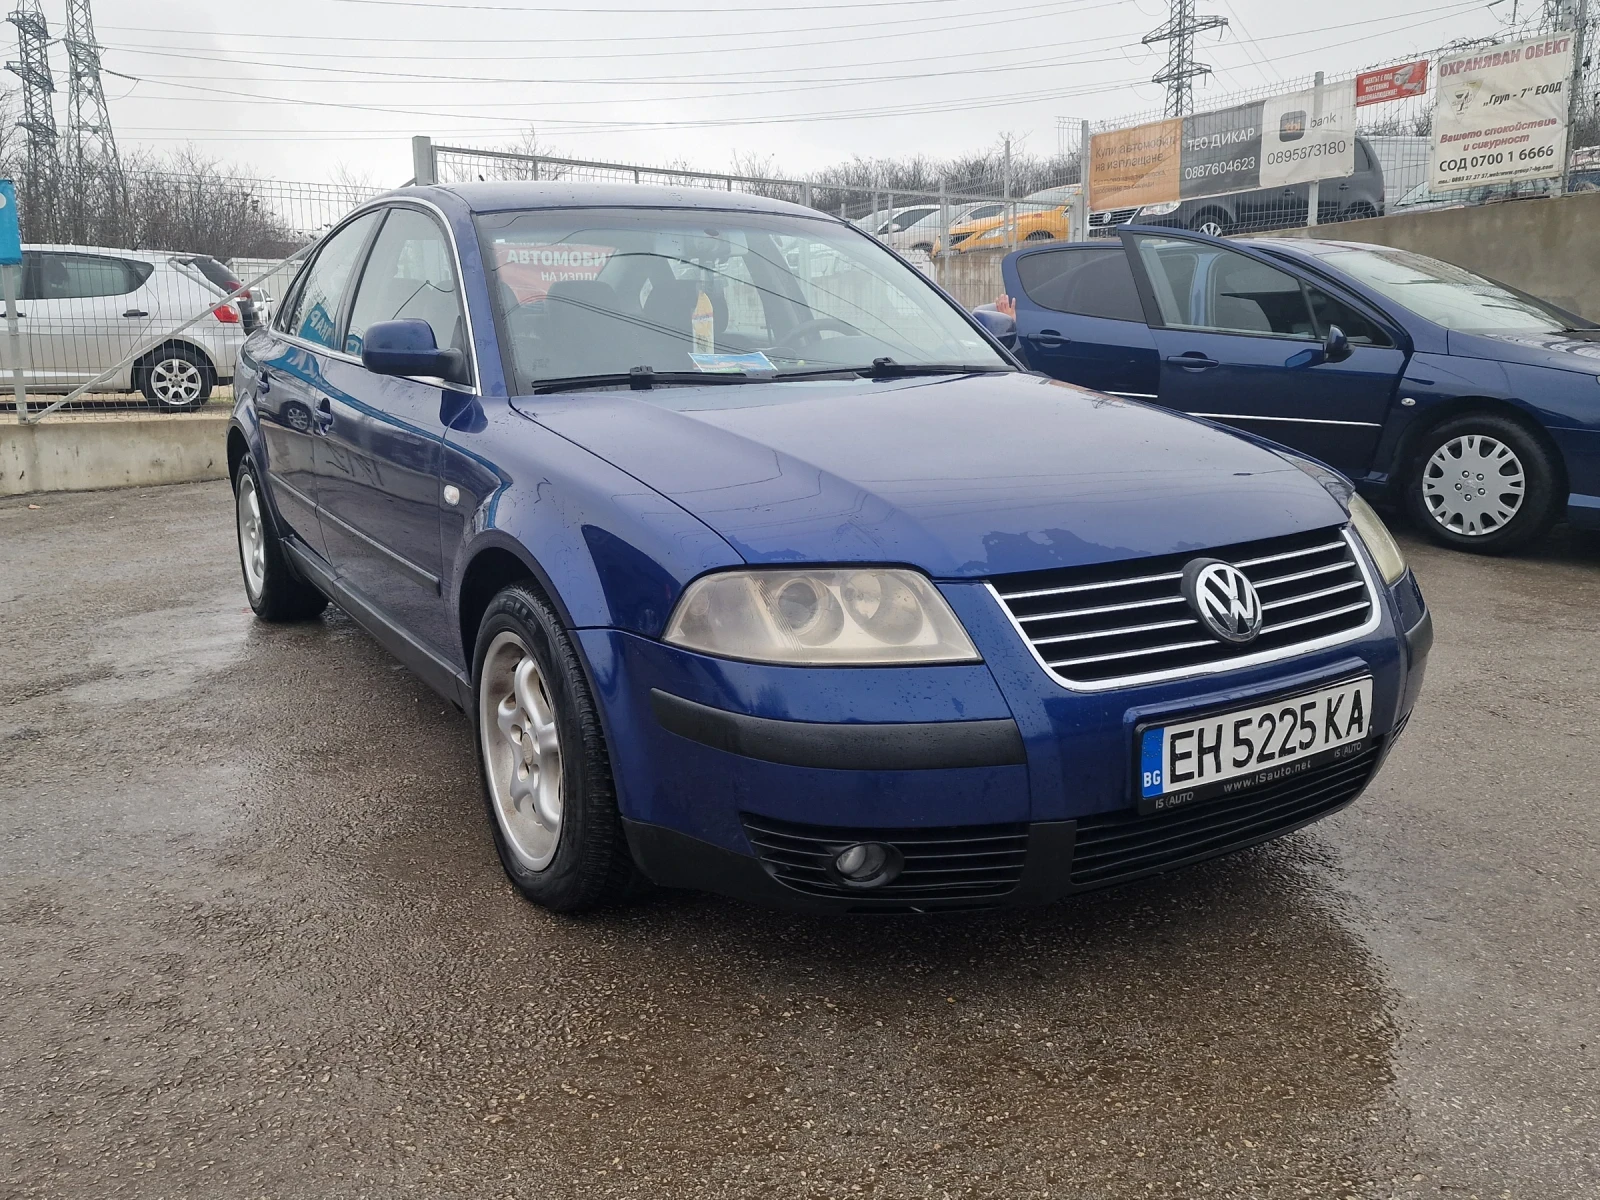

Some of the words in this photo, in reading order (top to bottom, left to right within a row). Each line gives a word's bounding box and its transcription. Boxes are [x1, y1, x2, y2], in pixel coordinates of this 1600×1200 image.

[1440, 48, 1521, 77] ОХРАНЯВАН
[1525, 38, 1570, 60] ОБЕКТ
[1535, 81, 1562, 96] ЕООД
[1310, 112, 1337, 129] bank
[1440, 129, 1482, 143] Вашето
[1484, 117, 1557, 137] спокойствие
[1095, 146, 1117, 160] Купи
[1119, 135, 1176, 154] автомобил
[1187, 136, 1207, 152] ТЕО
[1211, 127, 1255, 149] ДИКАР
[1463, 143, 1470, 151] и
[1472, 134, 1530, 151] сигурност
[1095, 164, 1104, 173] на
[1107, 152, 1164, 170] изплащане
[1267, 140, 1346, 165] 0895873180
[1439, 157, 1468, 173] СОД
[1471, 152, 1504, 168] 0700
[1508, 151, 1514, 162] 1
[1518, 144, 1554, 161] 6666
[1185, 156, 1256, 180] 0887604623
[506, 249, 611, 267] АВТОМОБИ
[541, 271, 557, 281] НА
[1170, 724, 1222, 784] EH
[1232, 701, 1317, 768] 5225
[1324, 689, 1364, 744] KA
[1143, 770, 1161, 788] BG
[1223, 760, 1311, 793] www.ISauto.net
